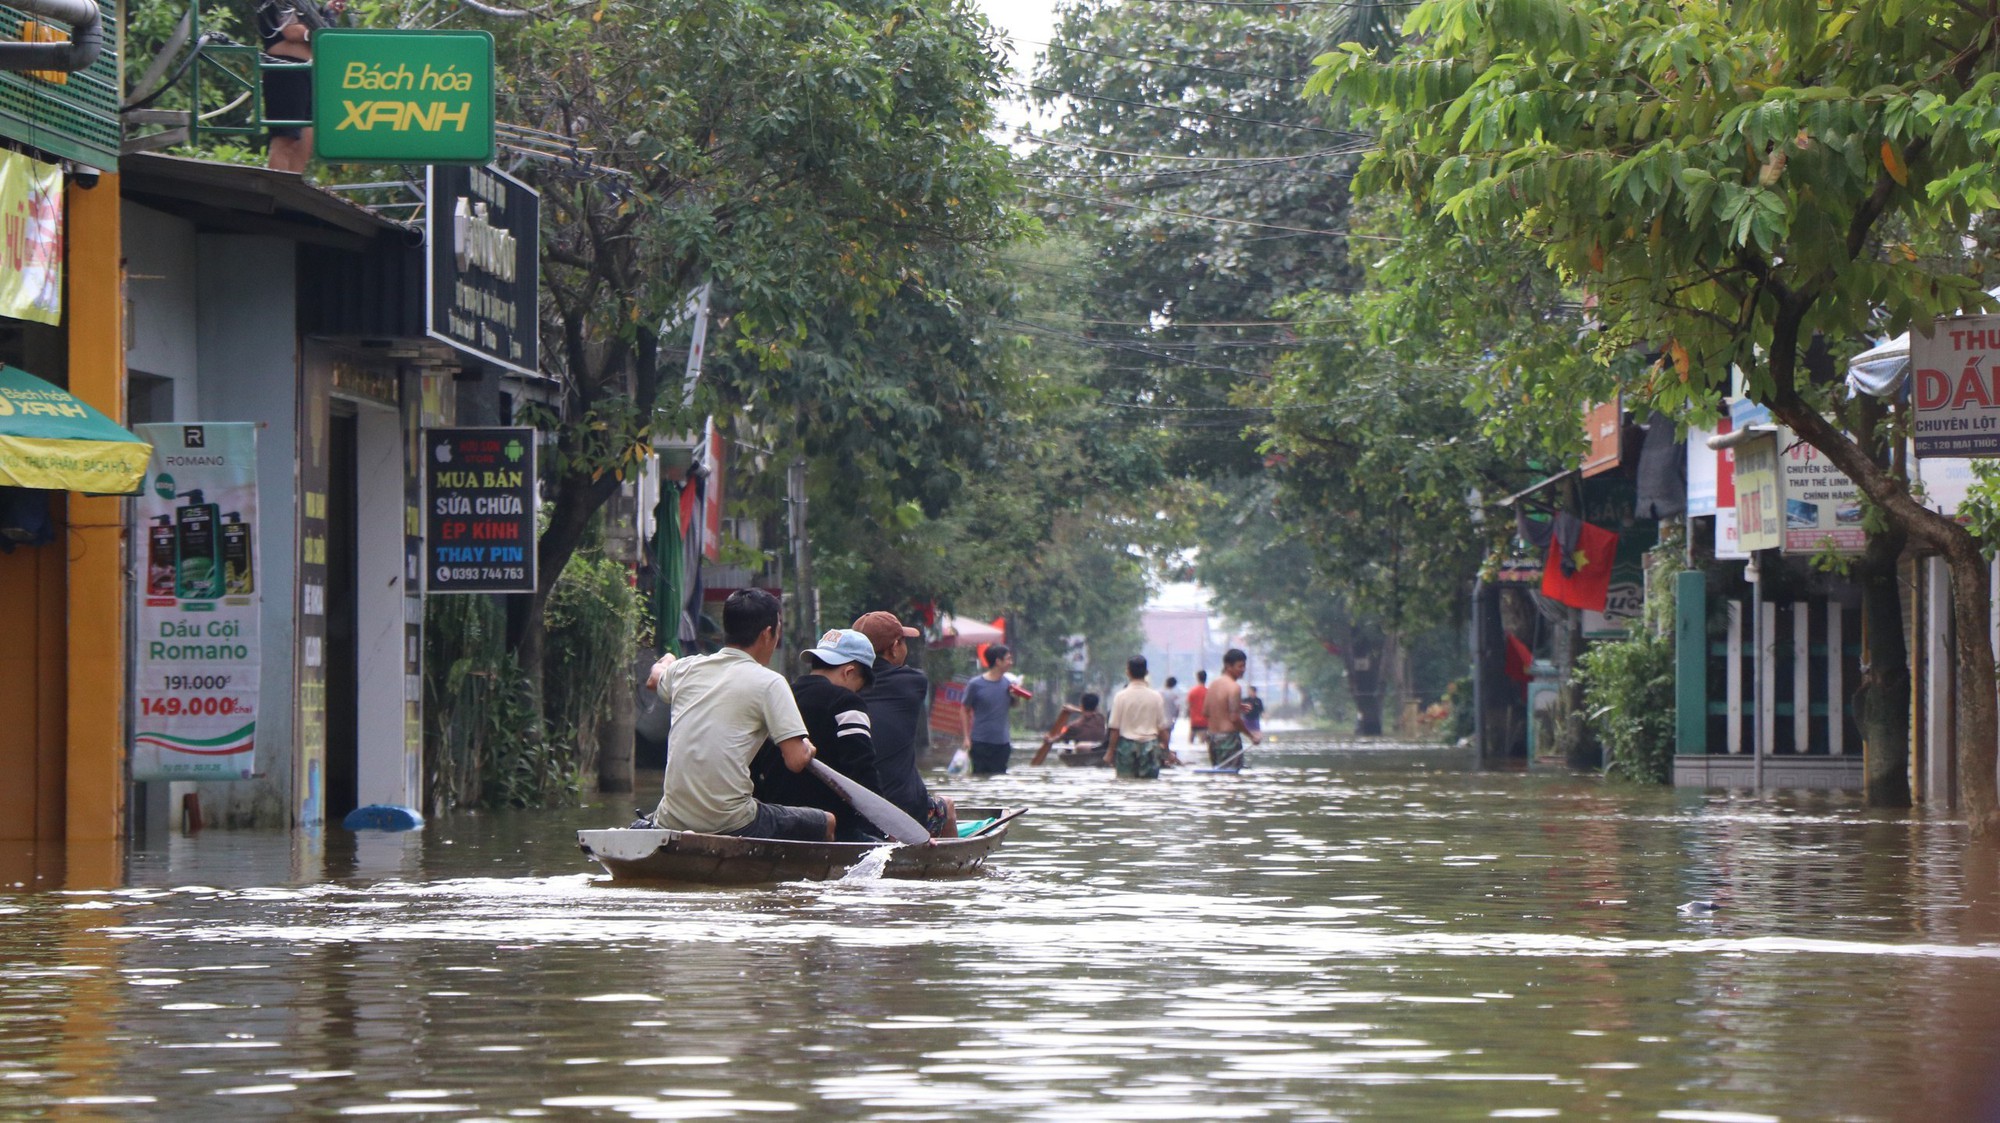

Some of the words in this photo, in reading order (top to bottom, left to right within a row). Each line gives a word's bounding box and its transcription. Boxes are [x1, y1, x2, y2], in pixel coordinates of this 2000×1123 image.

[342, 62, 414, 90] Bách
[420, 63, 473, 91] hóa
[335, 100, 471, 132] XANH
[1916, 355, 2000, 412] DÁ
[1916, 417, 1969, 432] CHUYÊN
[1973, 415, 1998, 432] LỘT
[1952, 439, 1972, 449] MAI
[167, 456, 225, 467] ROMANO
[1787, 464, 1820, 474] CHUYÊN
[436, 471, 479, 488] MUA
[483, 468, 523, 488] BÁN
[1789, 479, 1809, 487] THAY
[1812, 477, 1827, 487] THẾ
[1829, 479, 1849, 487] LINH
[436, 492, 472, 515] SỬA
[475, 494, 523, 515] CHỮA
[472, 519, 519, 540] KÍNH
[436, 547, 485, 562] THAY
[490, 546, 523, 562] PIN
[452, 567, 479, 580] 0393
[482, 567, 502, 580] 744
[504, 567, 524, 580] 763
[207, 620, 239, 641] Gội
[150, 641, 248, 660] Romano
